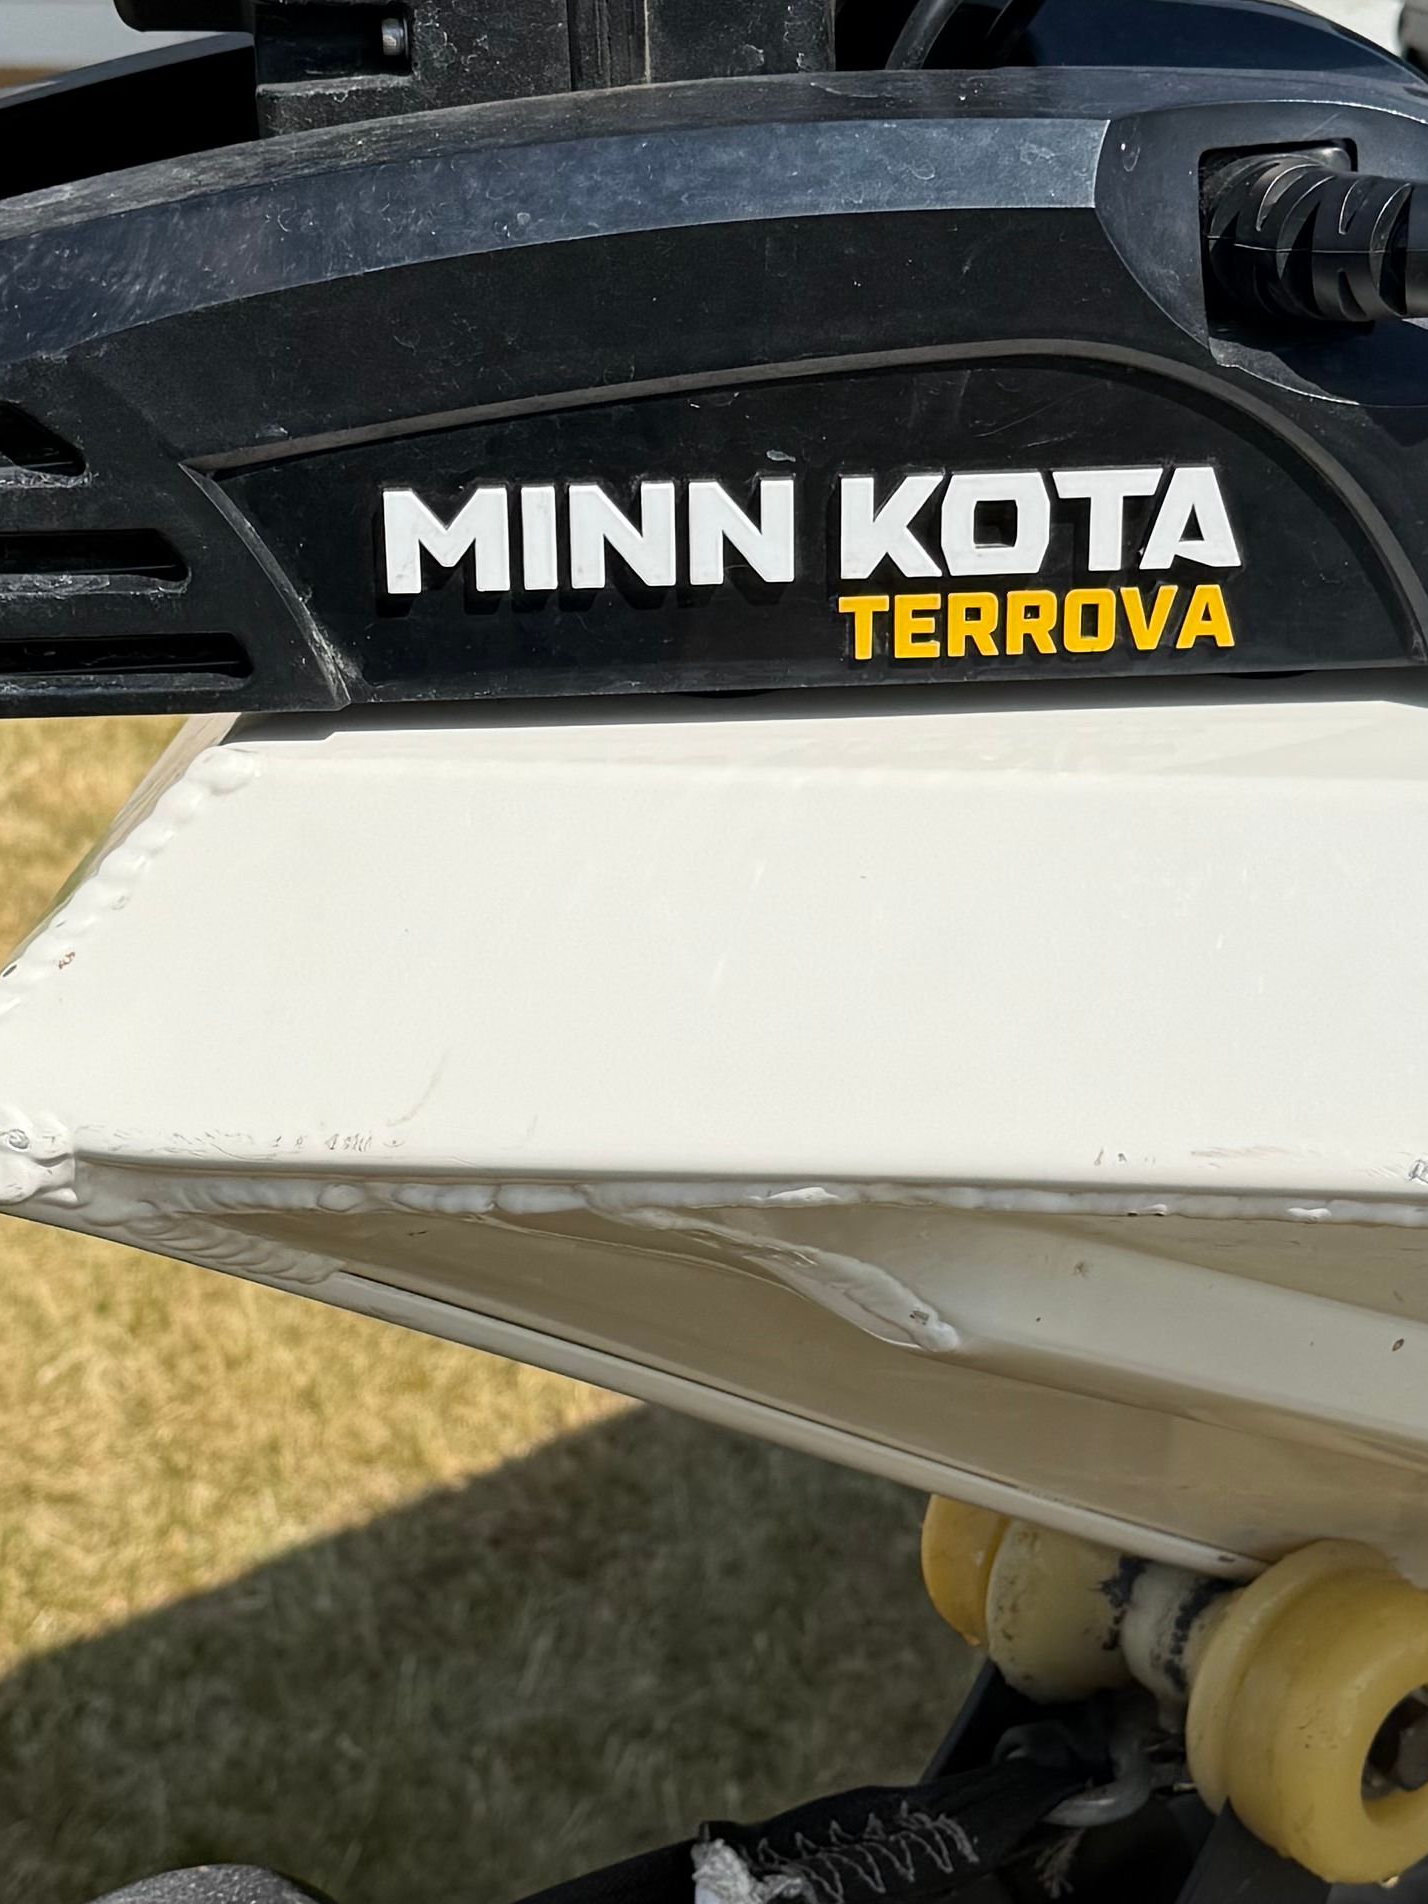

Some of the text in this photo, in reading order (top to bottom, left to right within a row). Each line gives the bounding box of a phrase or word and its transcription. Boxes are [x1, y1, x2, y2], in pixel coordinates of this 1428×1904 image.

[382, 466, 1241, 594] MINN KOTA
[838, 584, 1235, 661] TERROVA
